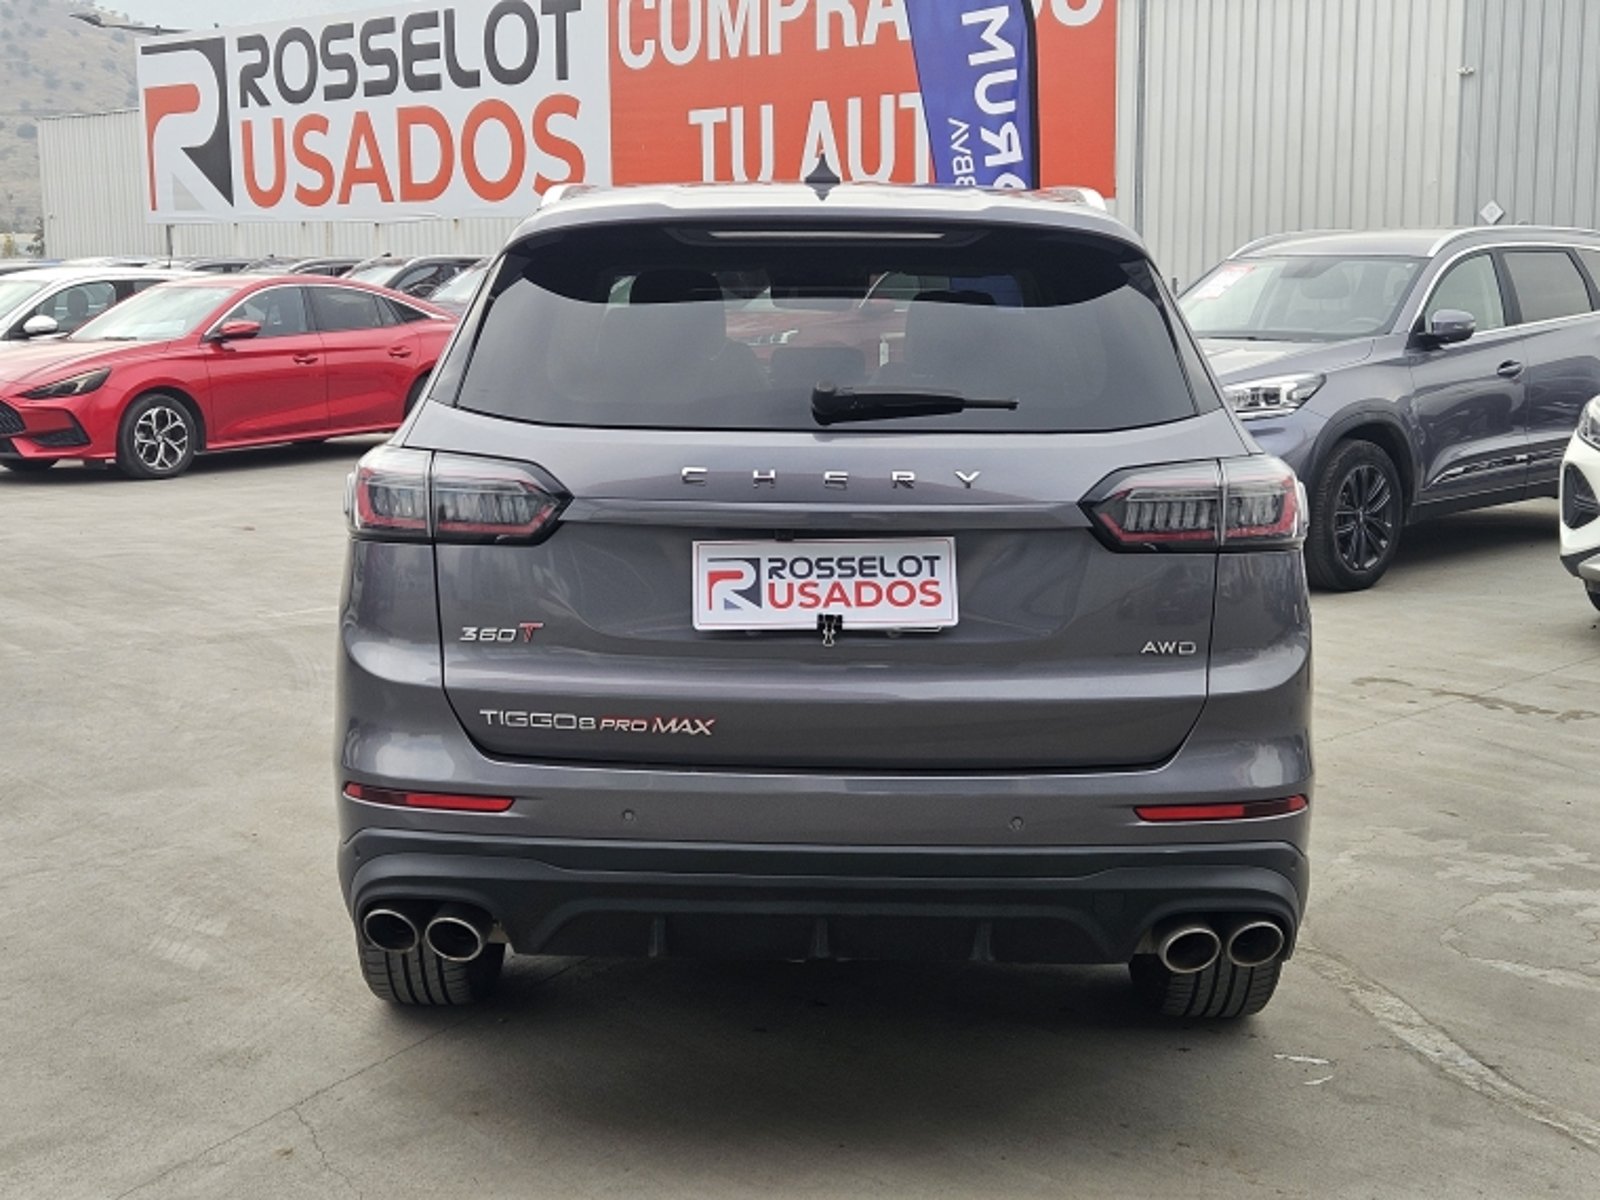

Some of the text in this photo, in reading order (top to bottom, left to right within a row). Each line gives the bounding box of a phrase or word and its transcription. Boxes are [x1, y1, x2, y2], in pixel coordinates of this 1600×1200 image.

[236, 0, 582, 109] ROSSELOT
[688, 92, 930, 185] TU AUT
[241, 94, 586, 209] USADOS
[680, 466, 981, 490] CHERY
[767, 555, 942, 580] ROSSELOT
[768, 580, 943, 610] USADOS
[459, 622, 544, 643] 360T
[1140, 640, 1197, 655] AWD
[599, 718, 648, 732] PRO
[651, 716, 716, 736] MAX
